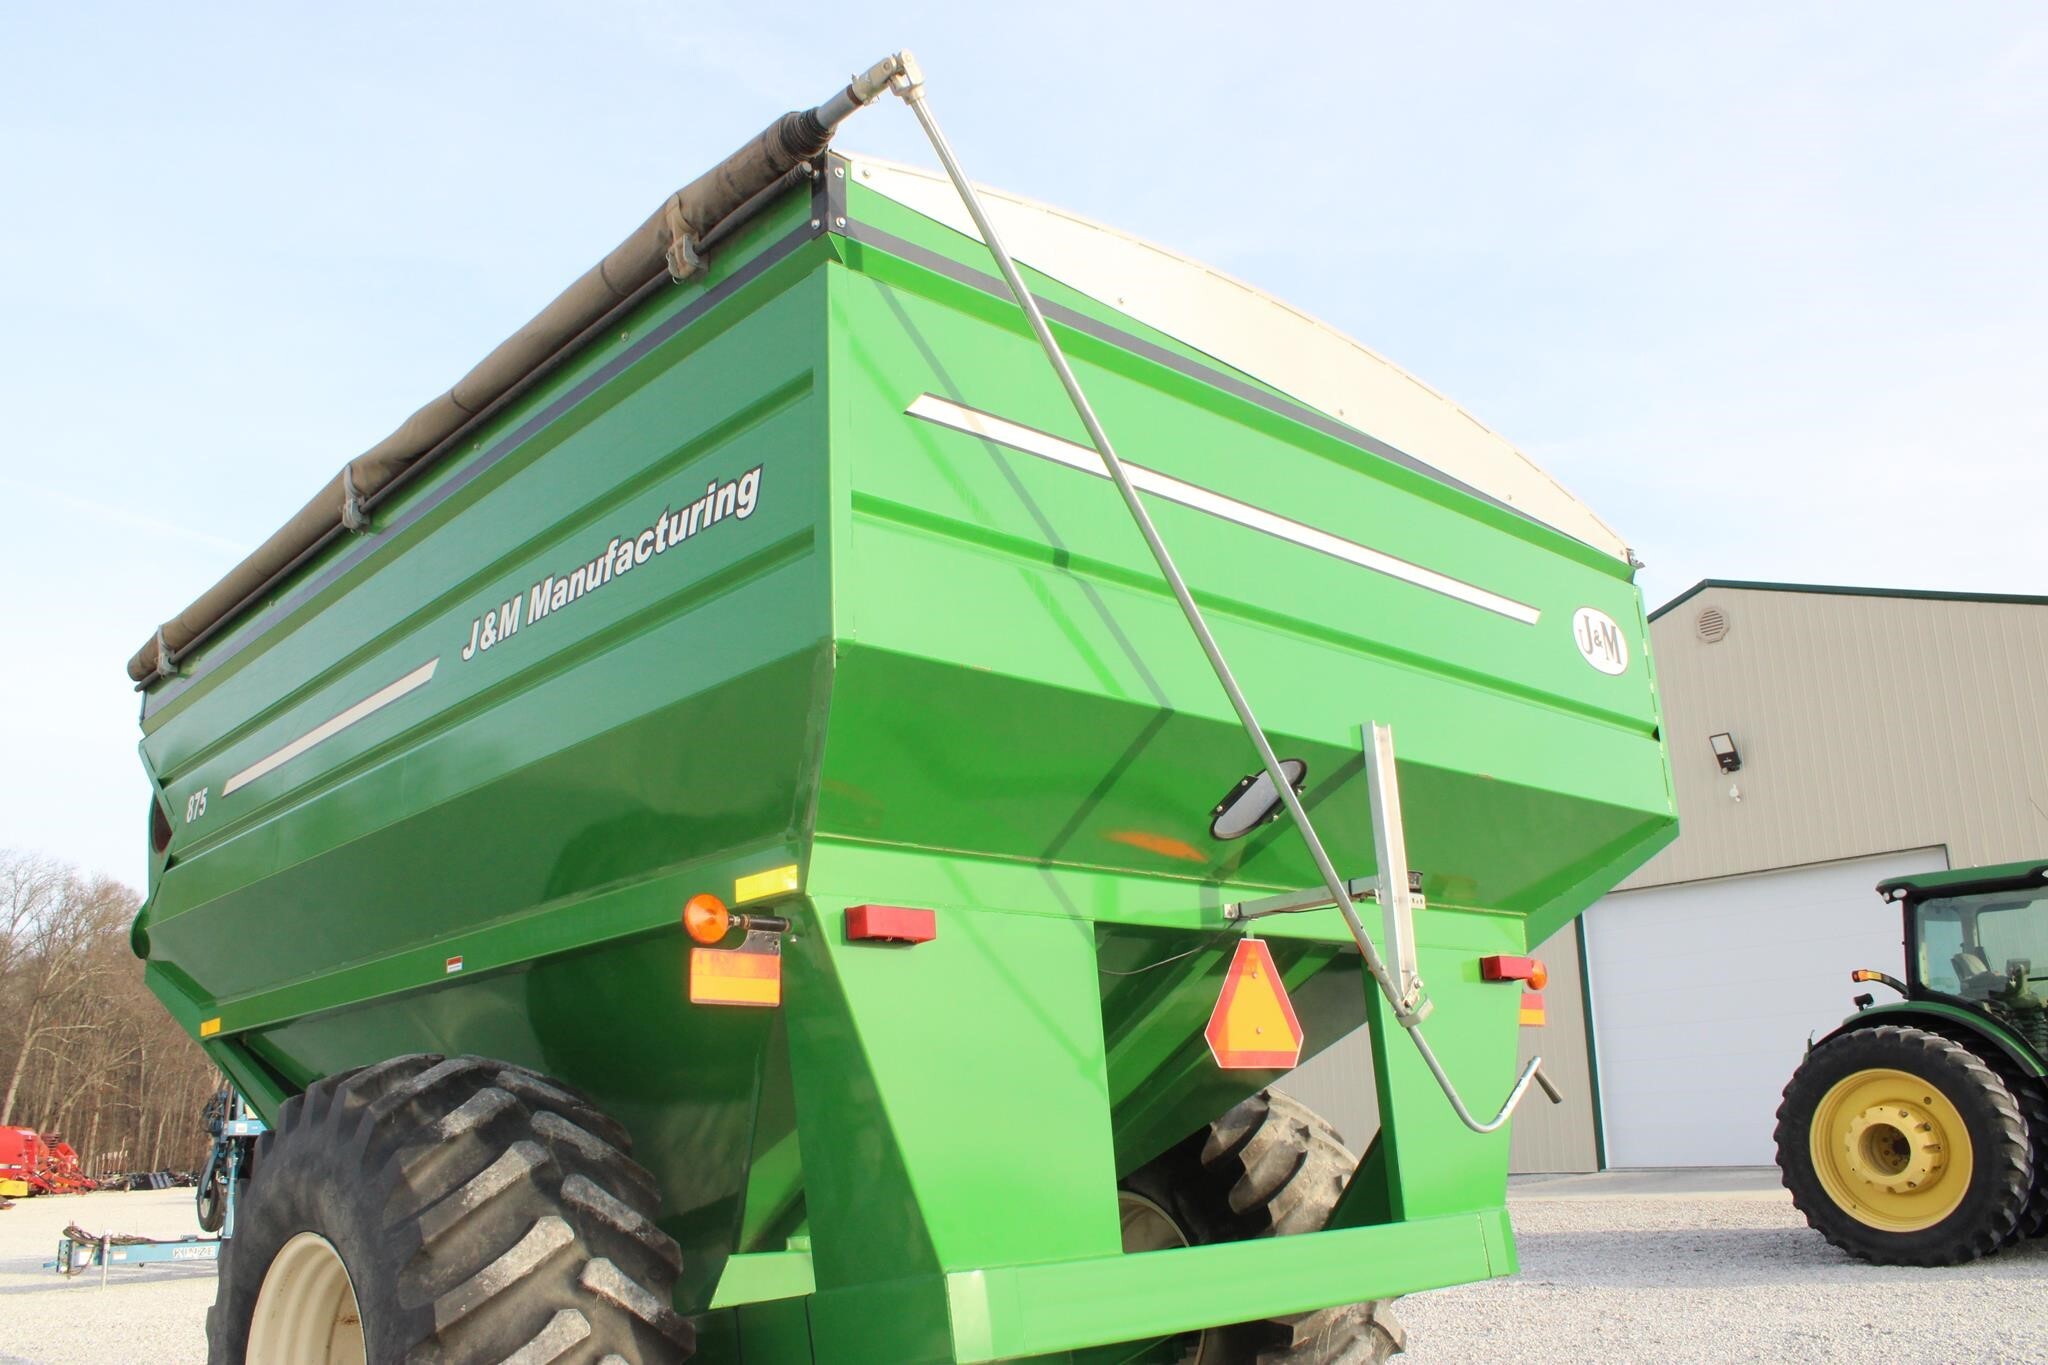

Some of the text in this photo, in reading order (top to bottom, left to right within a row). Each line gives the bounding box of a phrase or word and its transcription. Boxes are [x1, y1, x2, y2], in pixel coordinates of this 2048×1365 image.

[461, 463, 764, 661] J&M Manufacturing
[1578, 614, 1623, 665] J&M
[186, 786, 208, 823] 875
